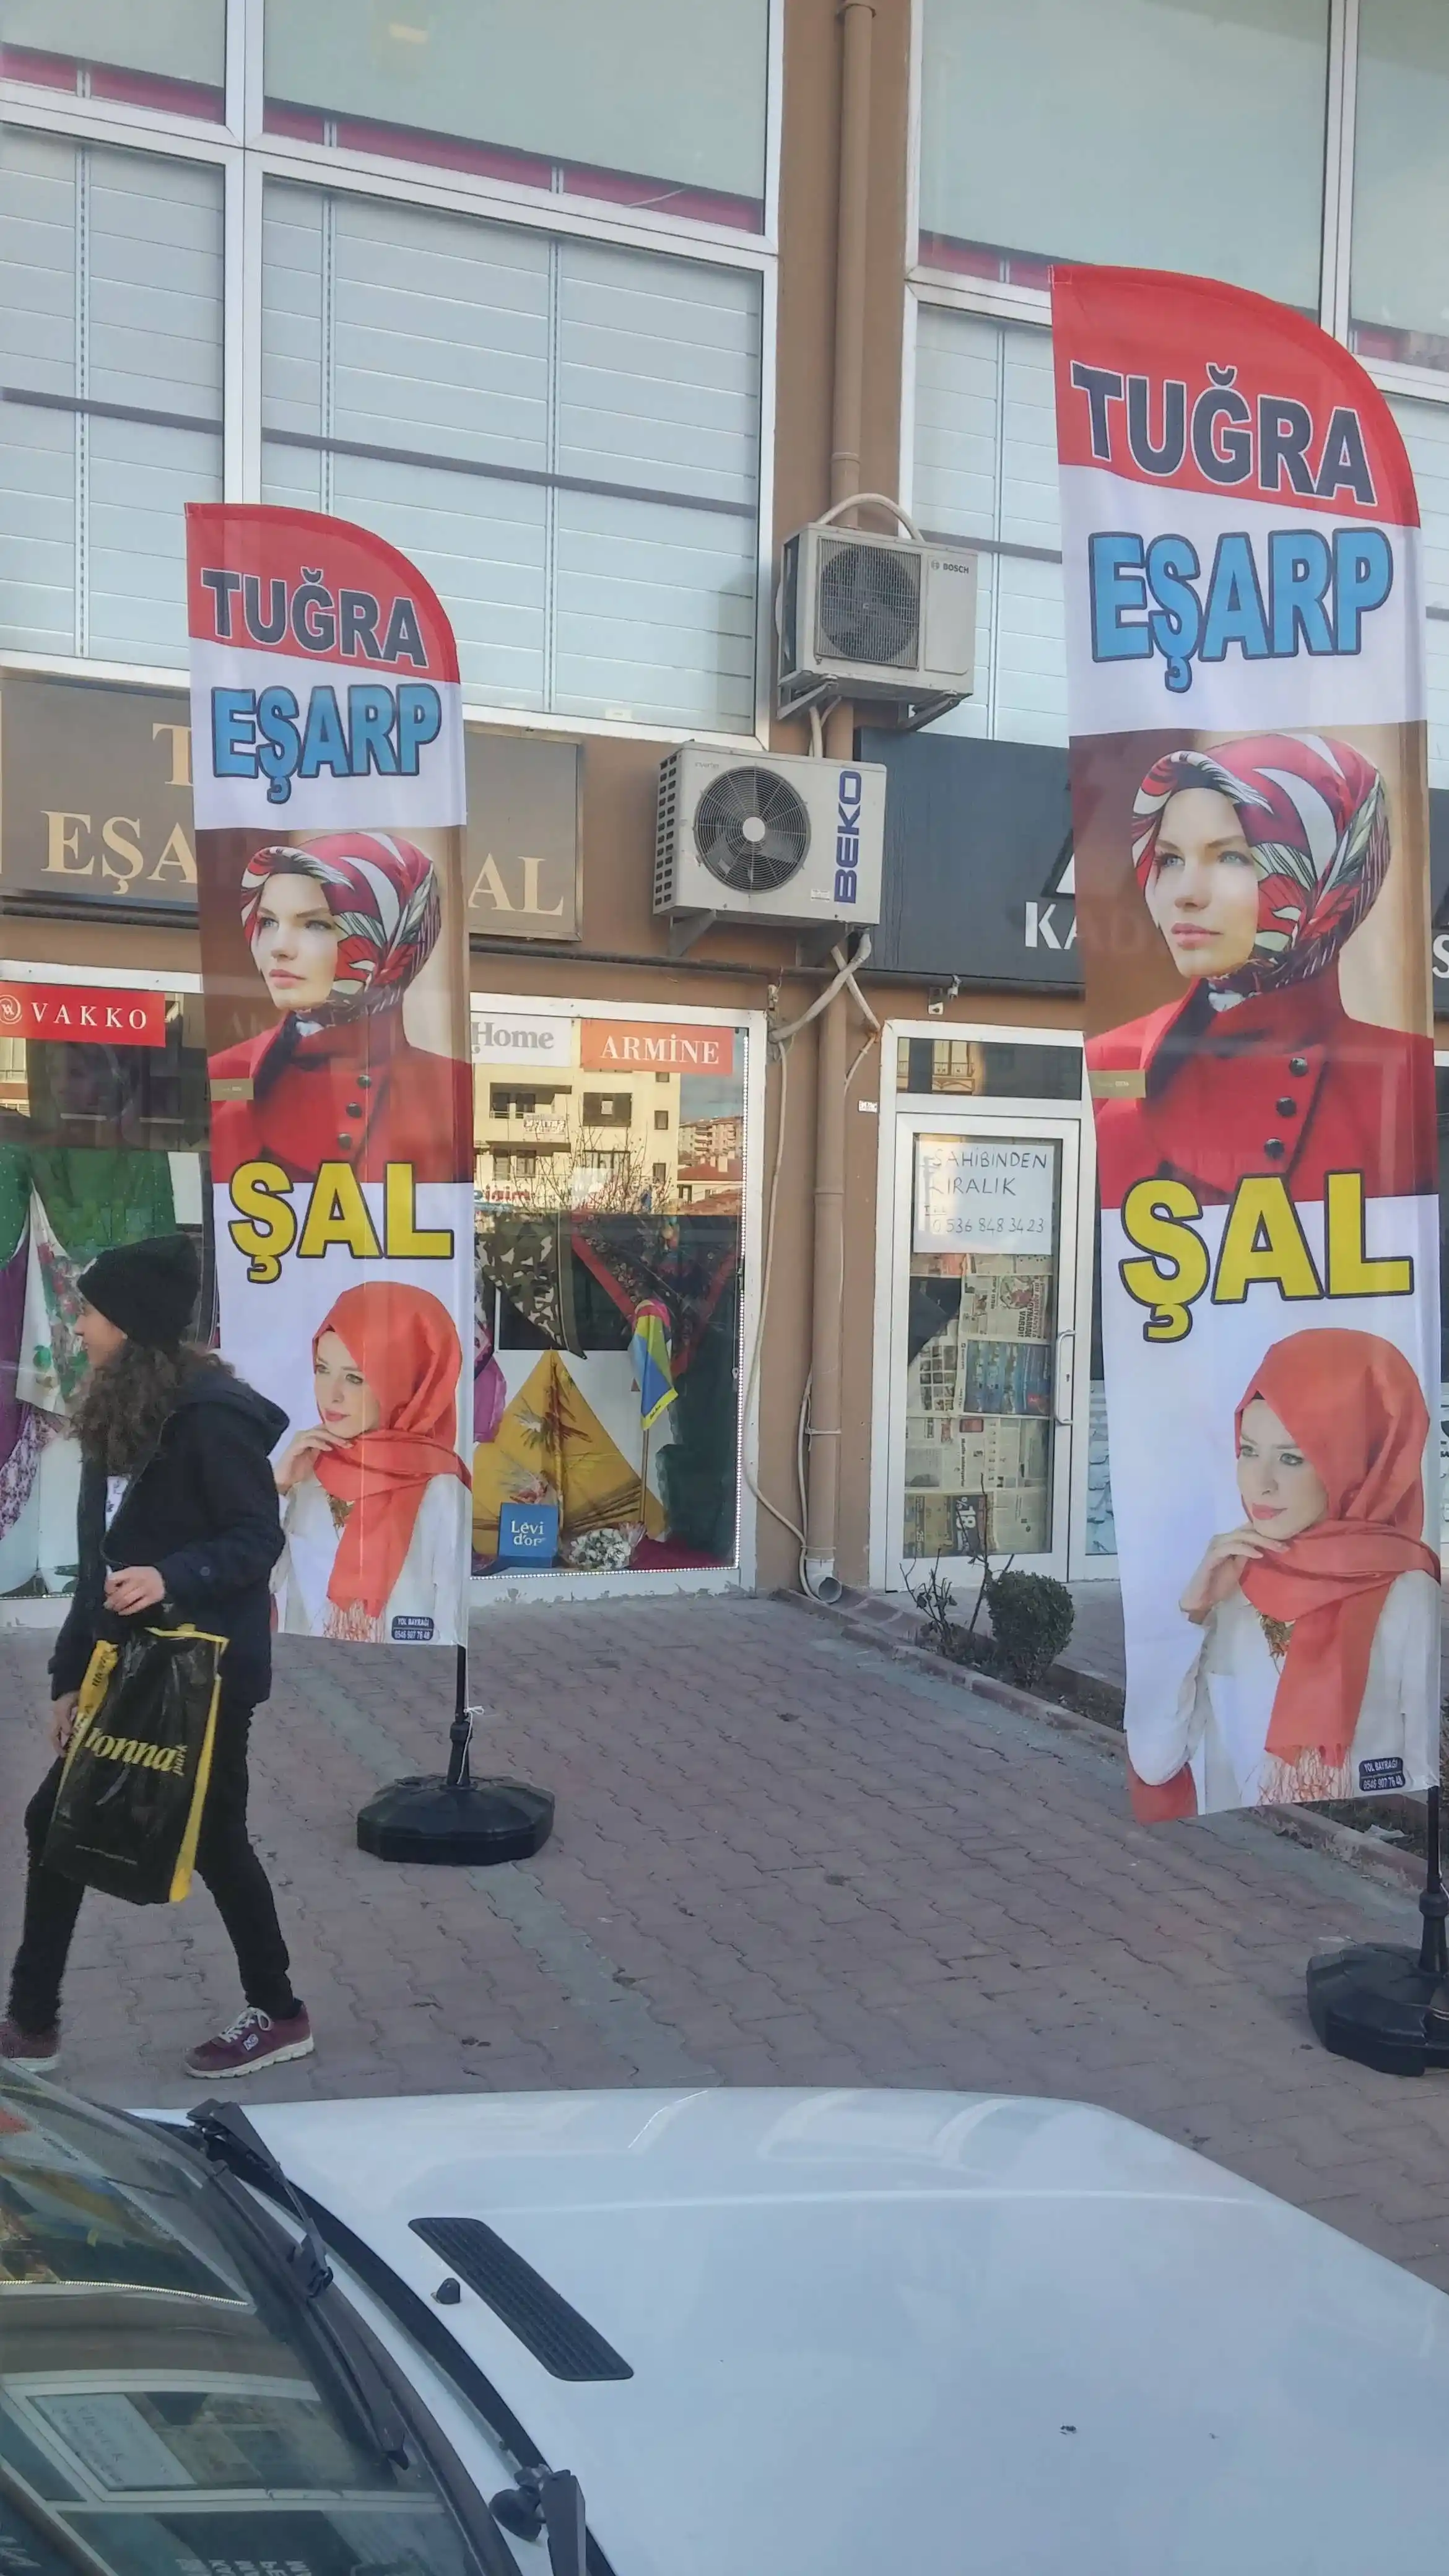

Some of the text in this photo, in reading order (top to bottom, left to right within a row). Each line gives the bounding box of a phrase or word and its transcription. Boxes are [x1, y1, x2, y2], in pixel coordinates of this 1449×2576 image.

[1071, 360, 1378, 506] TUĞRA
[201, 566, 429, 668] TUĞRA
[943, 563, 969, 574] BOSCH
[1088, 527, 1393, 693] EŞARP
[211, 683, 442, 804] EŞARP
[40, 811, 564, 916] EŞA AL
[834, 770, 862, 903] BEKO
[31, 1002, 147, 1029] VAKKO
[471, 1021, 554, 1050] Home
[599, 1033, 720, 1064] ARMİNE
[228, 1160, 455, 1284] ŞAL
[946, 1219, 972, 1233] 536
[978, 1217, 1004, 1235] 848
[1118, 1170, 1414, 1343] ŞAL
[1364, 1762, 1375, 1773] YOL
